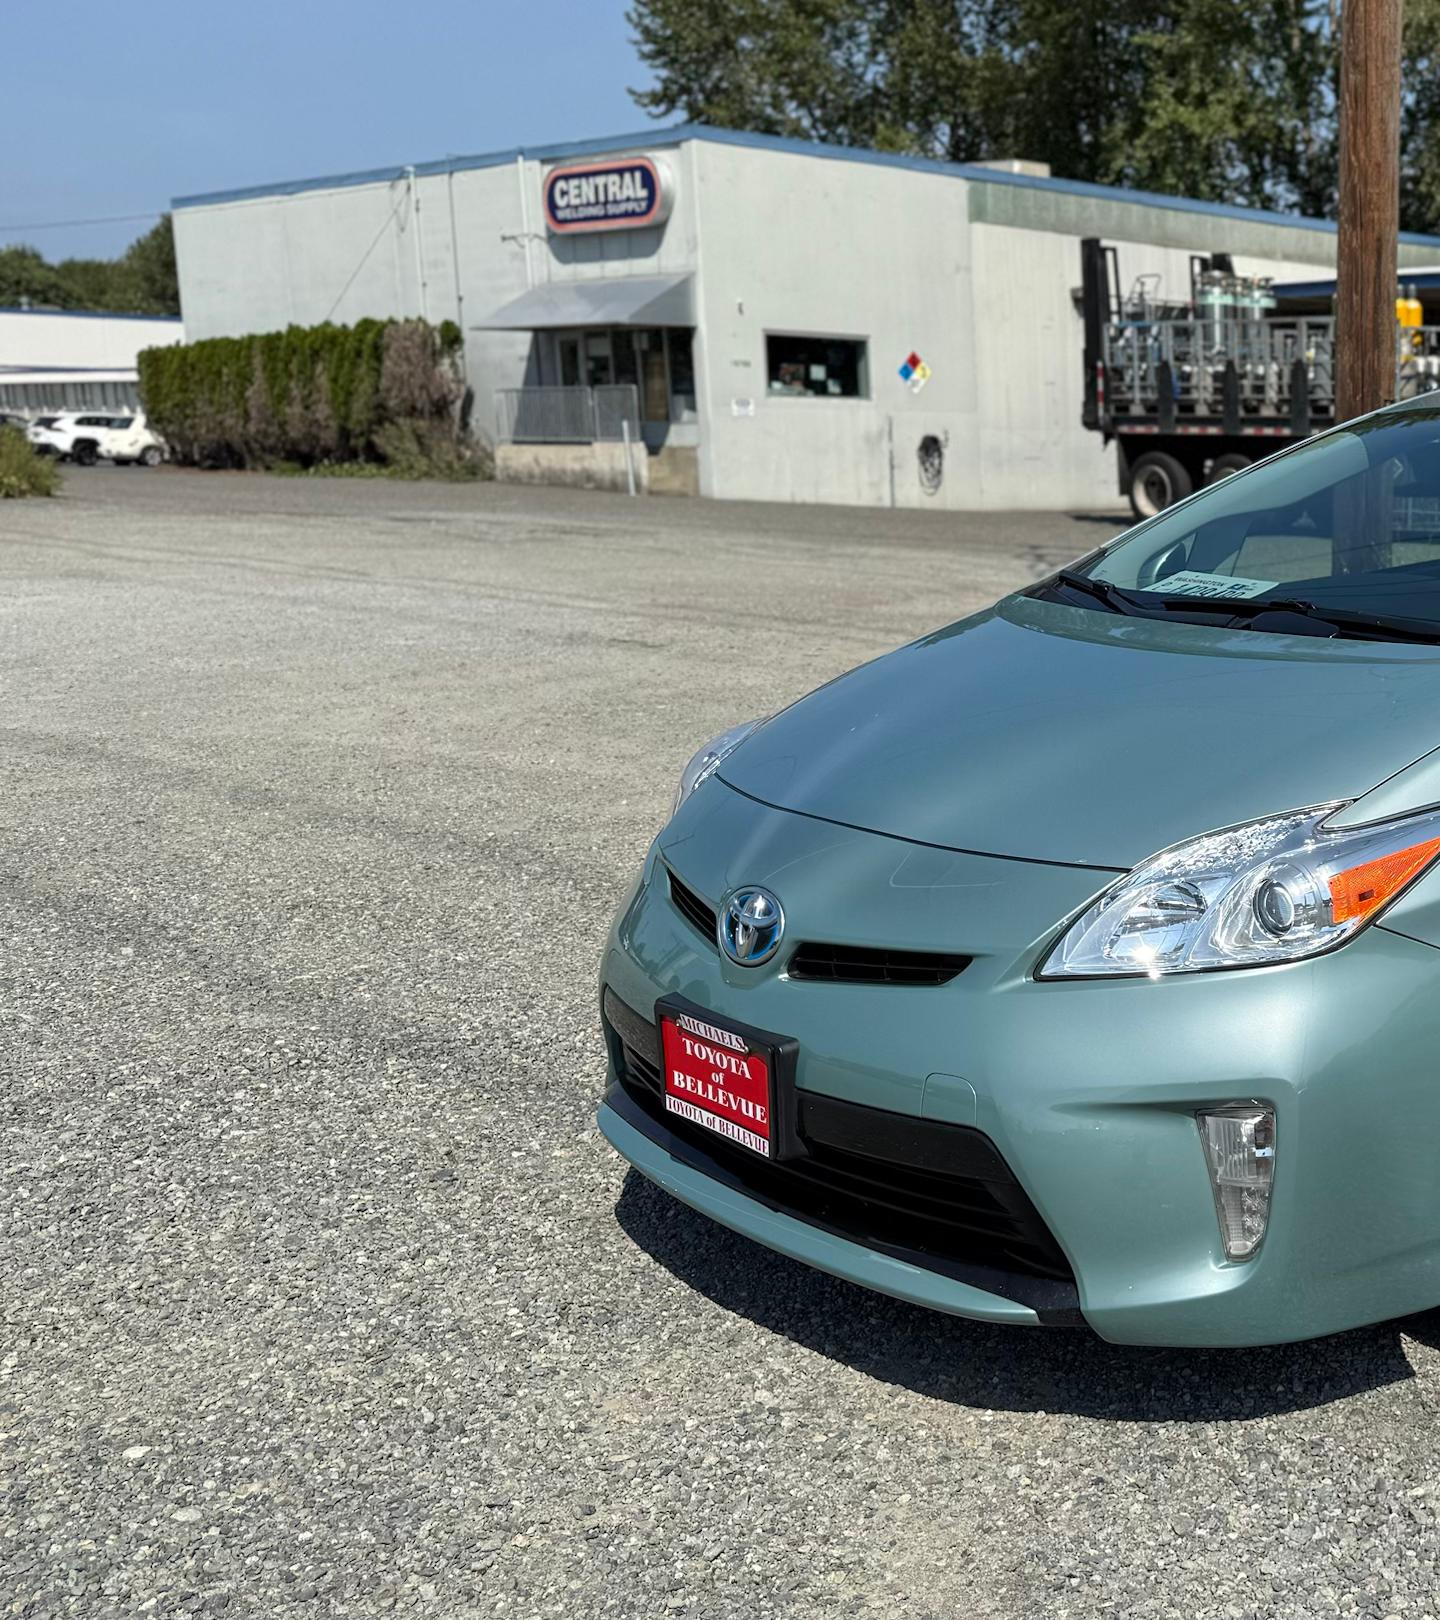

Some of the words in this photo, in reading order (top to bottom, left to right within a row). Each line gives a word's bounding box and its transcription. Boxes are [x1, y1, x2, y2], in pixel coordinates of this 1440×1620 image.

[553, 170, 649, 208] CENTRAL
[682, 1037, 752, 1080] TOYOTA
[711, 1071, 725, 1086] of
[672, 1070, 767, 1124] BELLEVUE
[667, 1096, 704, 1124] TOYOTA
[706, 1114, 717, 1130] of
[719, 1119, 769, 1155] BELLEVUE
